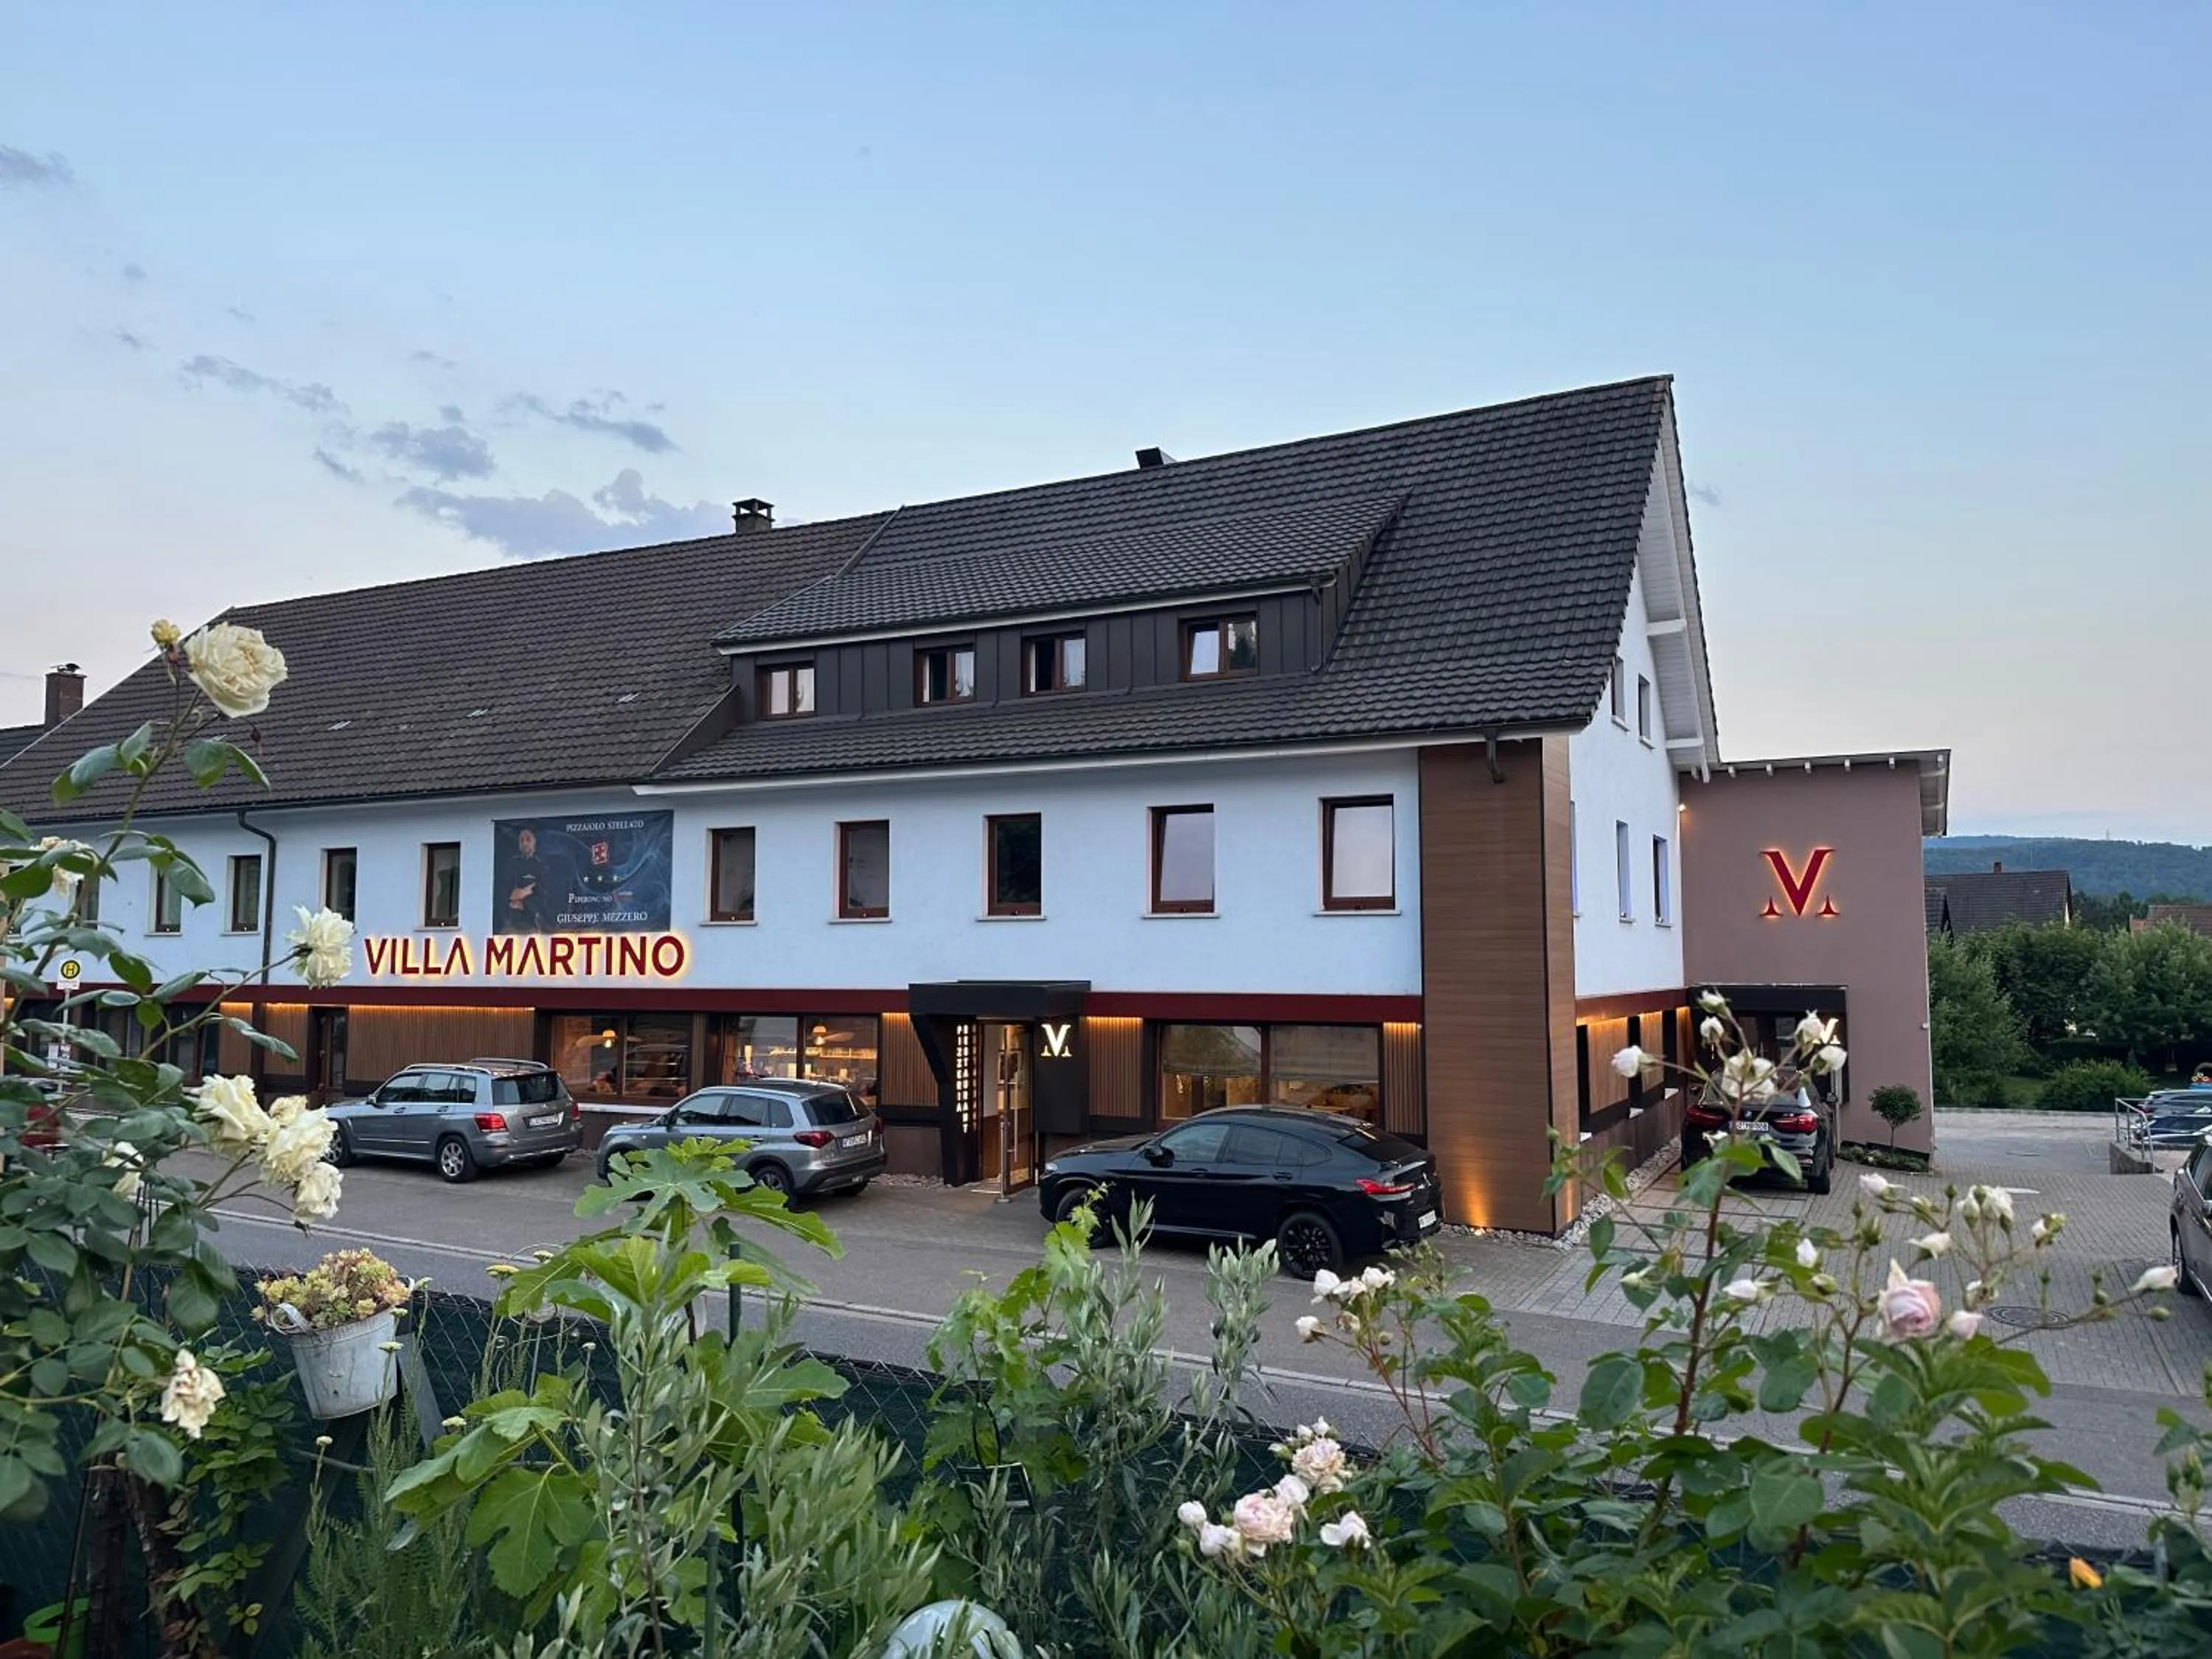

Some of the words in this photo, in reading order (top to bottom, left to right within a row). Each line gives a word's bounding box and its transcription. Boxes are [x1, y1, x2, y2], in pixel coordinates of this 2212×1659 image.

[557, 913, 599, 924] GIUSEPPE
[601, 911, 648, 923] MEZZERO
[364, 937, 470, 975] VILLA
[484, 935, 685, 976] MARTINO
